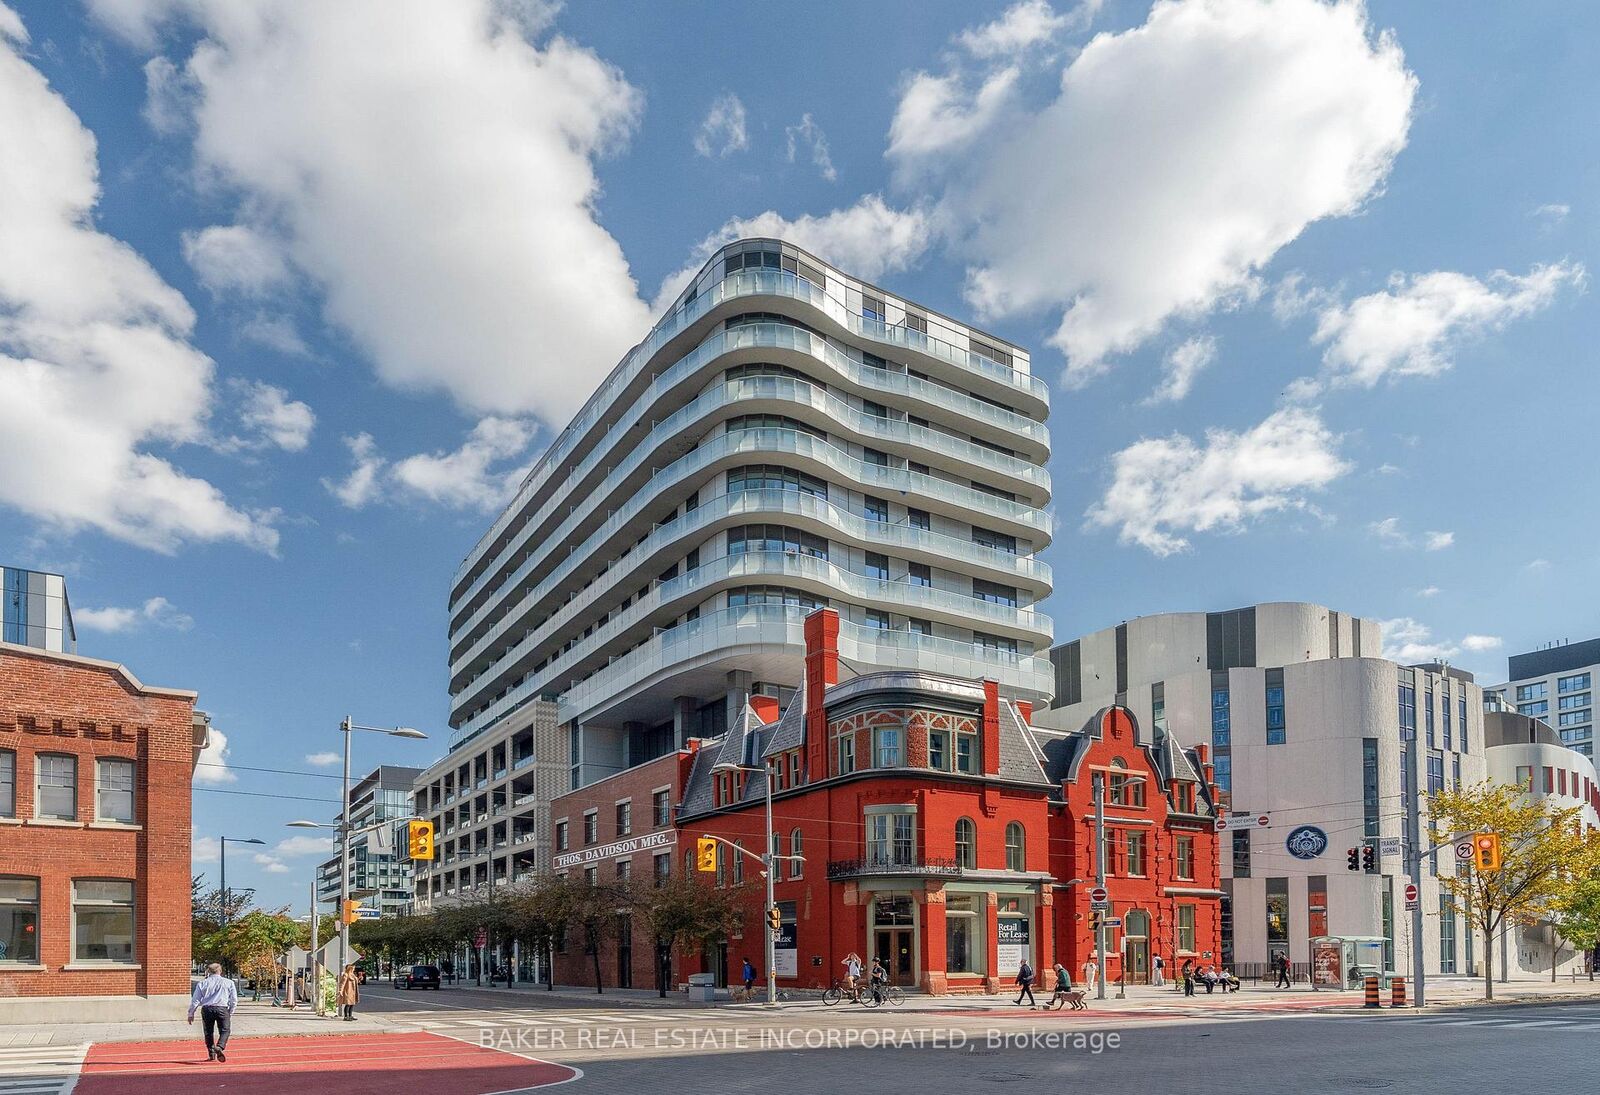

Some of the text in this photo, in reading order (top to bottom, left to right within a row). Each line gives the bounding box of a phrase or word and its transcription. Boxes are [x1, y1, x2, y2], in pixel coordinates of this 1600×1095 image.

[558, 834, 669, 866] THOS. DAVIDSON MFG.
[998, 923, 1017, 931] Retail
